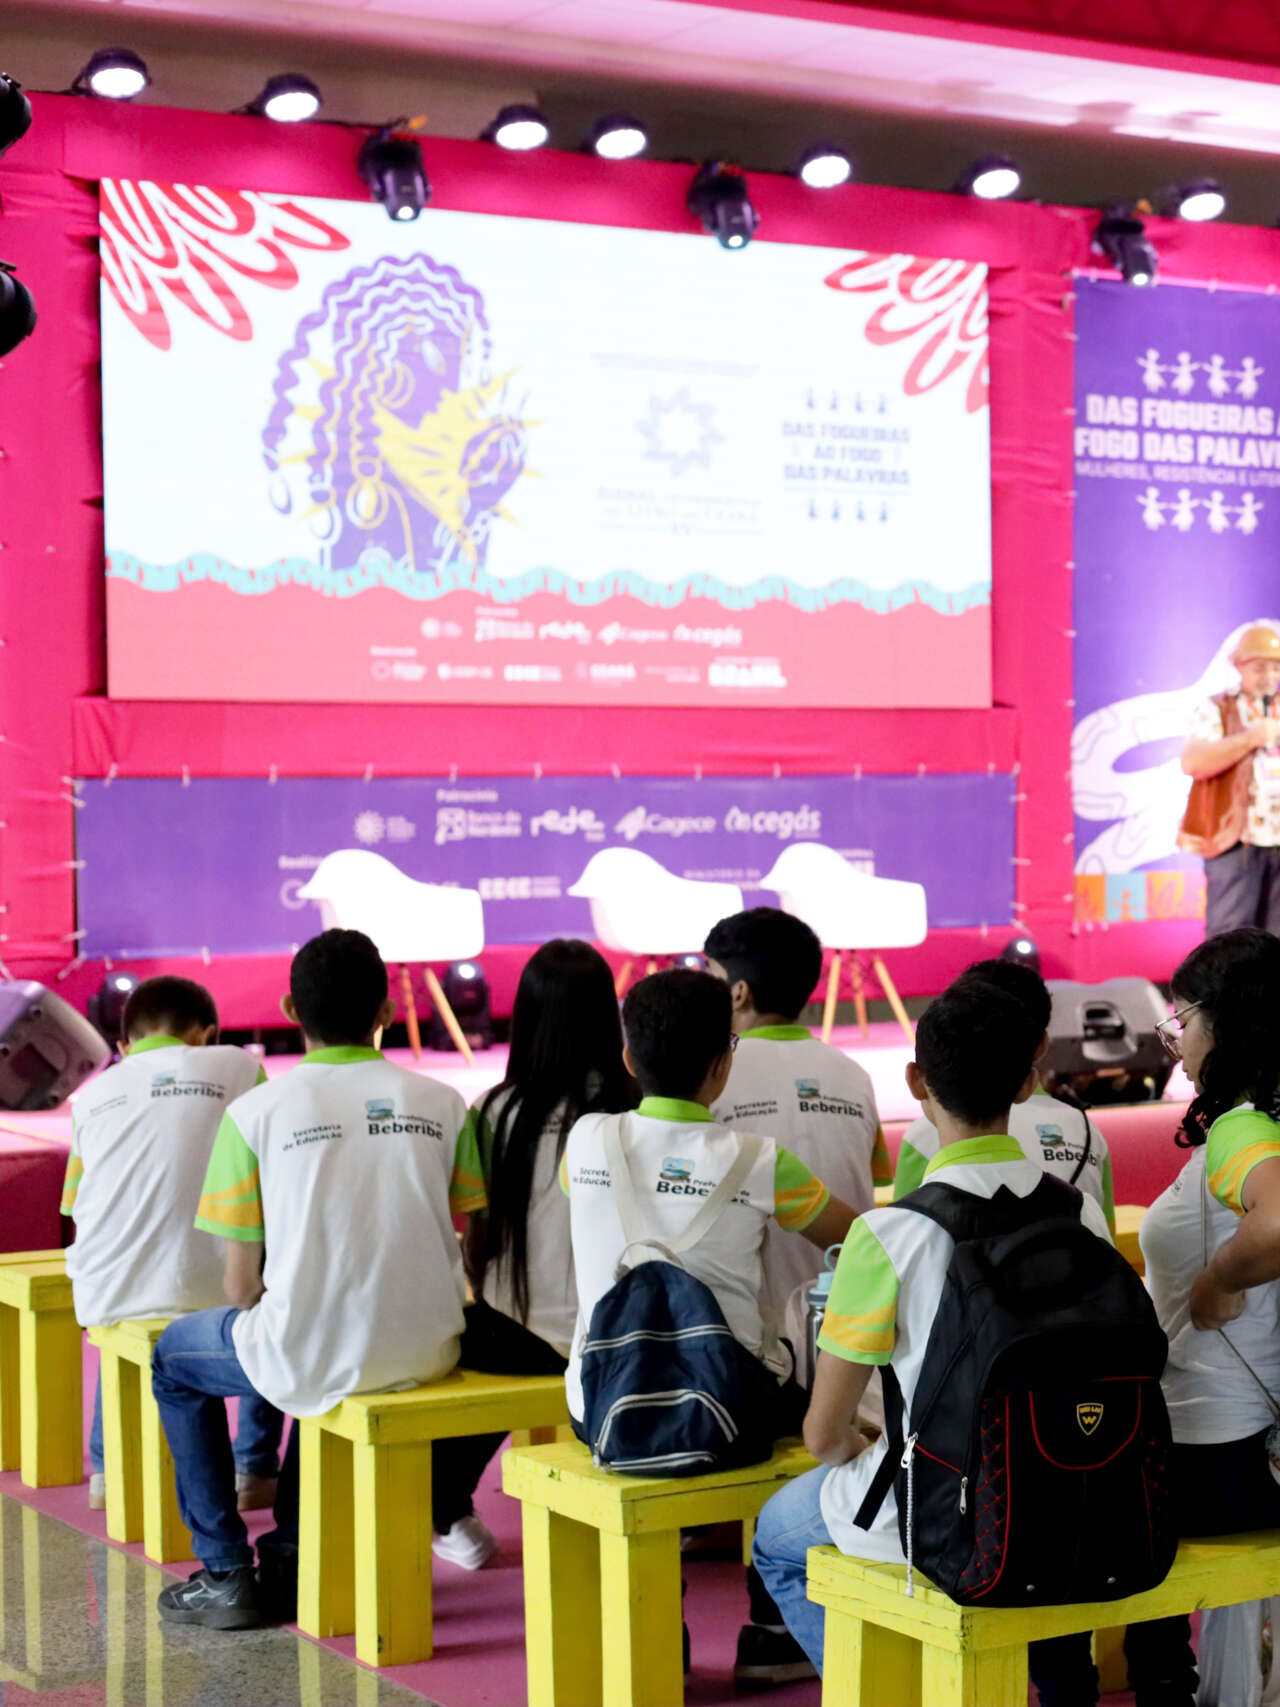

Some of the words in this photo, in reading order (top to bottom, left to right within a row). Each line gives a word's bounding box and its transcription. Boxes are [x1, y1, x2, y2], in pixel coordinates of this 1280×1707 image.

[1086, 394, 1139, 426] DAS
[1143, 398, 1275, 434] FOGUEIRAS
[1074, 427, 1140, 460] FOGO
[1142, 432, 1195, 463] DAS
[150, 1087, 226, 1100] Beberibe
[799, 1100, 865, 1119] Beberibe
[368, 1121, 444, 1141] Beberibe
